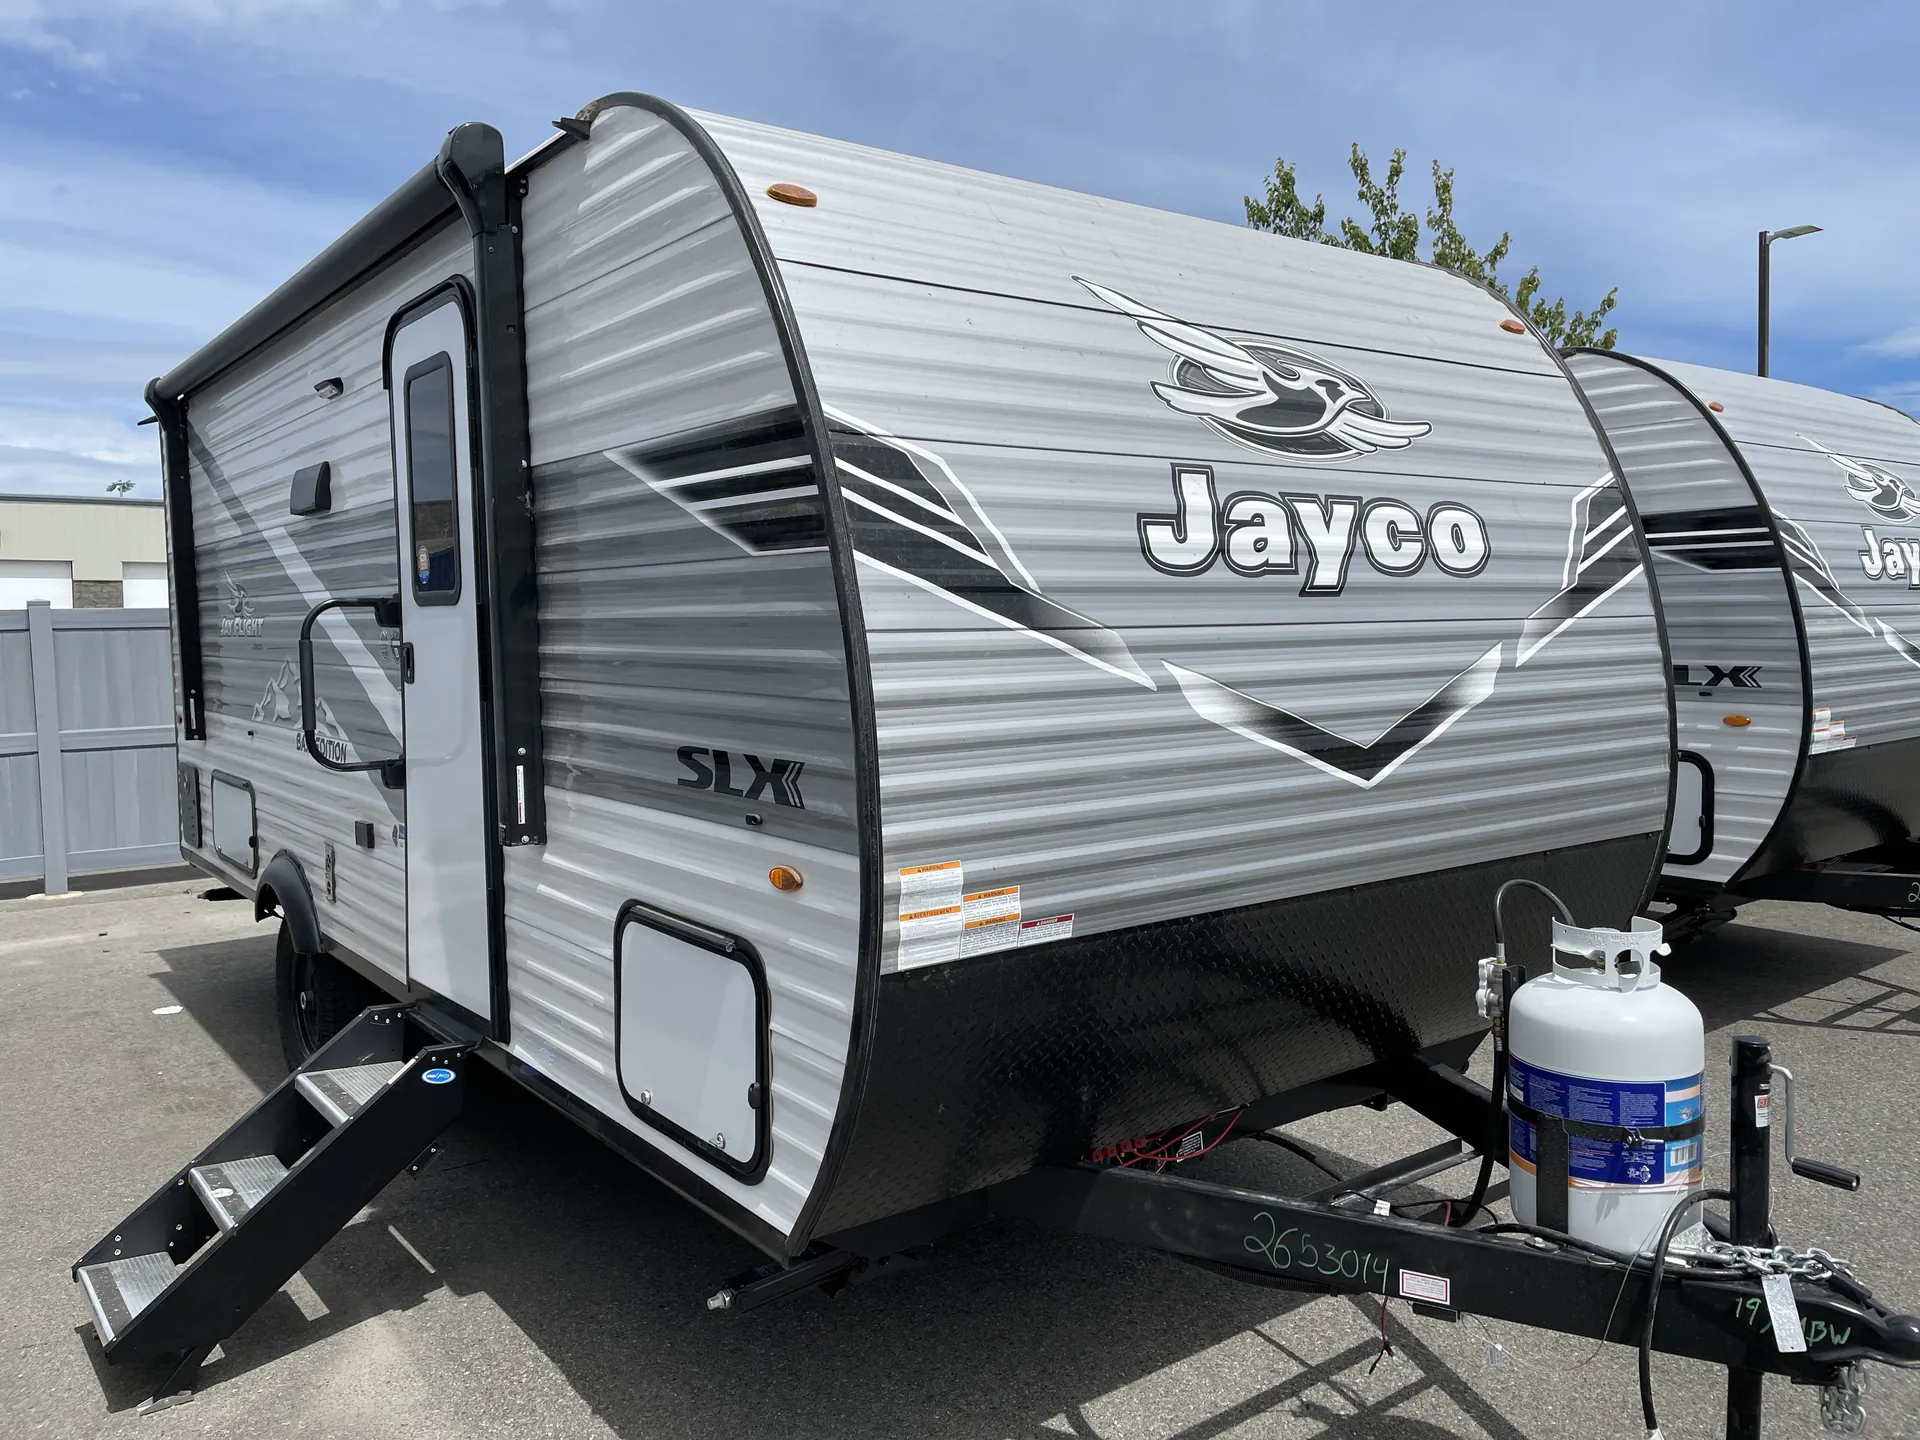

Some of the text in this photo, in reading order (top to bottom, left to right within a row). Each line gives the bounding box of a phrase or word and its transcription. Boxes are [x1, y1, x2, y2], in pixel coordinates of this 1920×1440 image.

[1137, 462, 1491, 597] Jayco
[220, 616, 264, 637] JAY FLIGHT
[677, 746, 806, 810] SLX
[921, 863, 945, 873] WARNING
[983, 890, 1005, 899] WARNING
[913, 907, 953, 919] AVERTISSEMENT
[985, 916, 1007, 926] WARNING
[1040, 918, 1059, 927] DANGER
